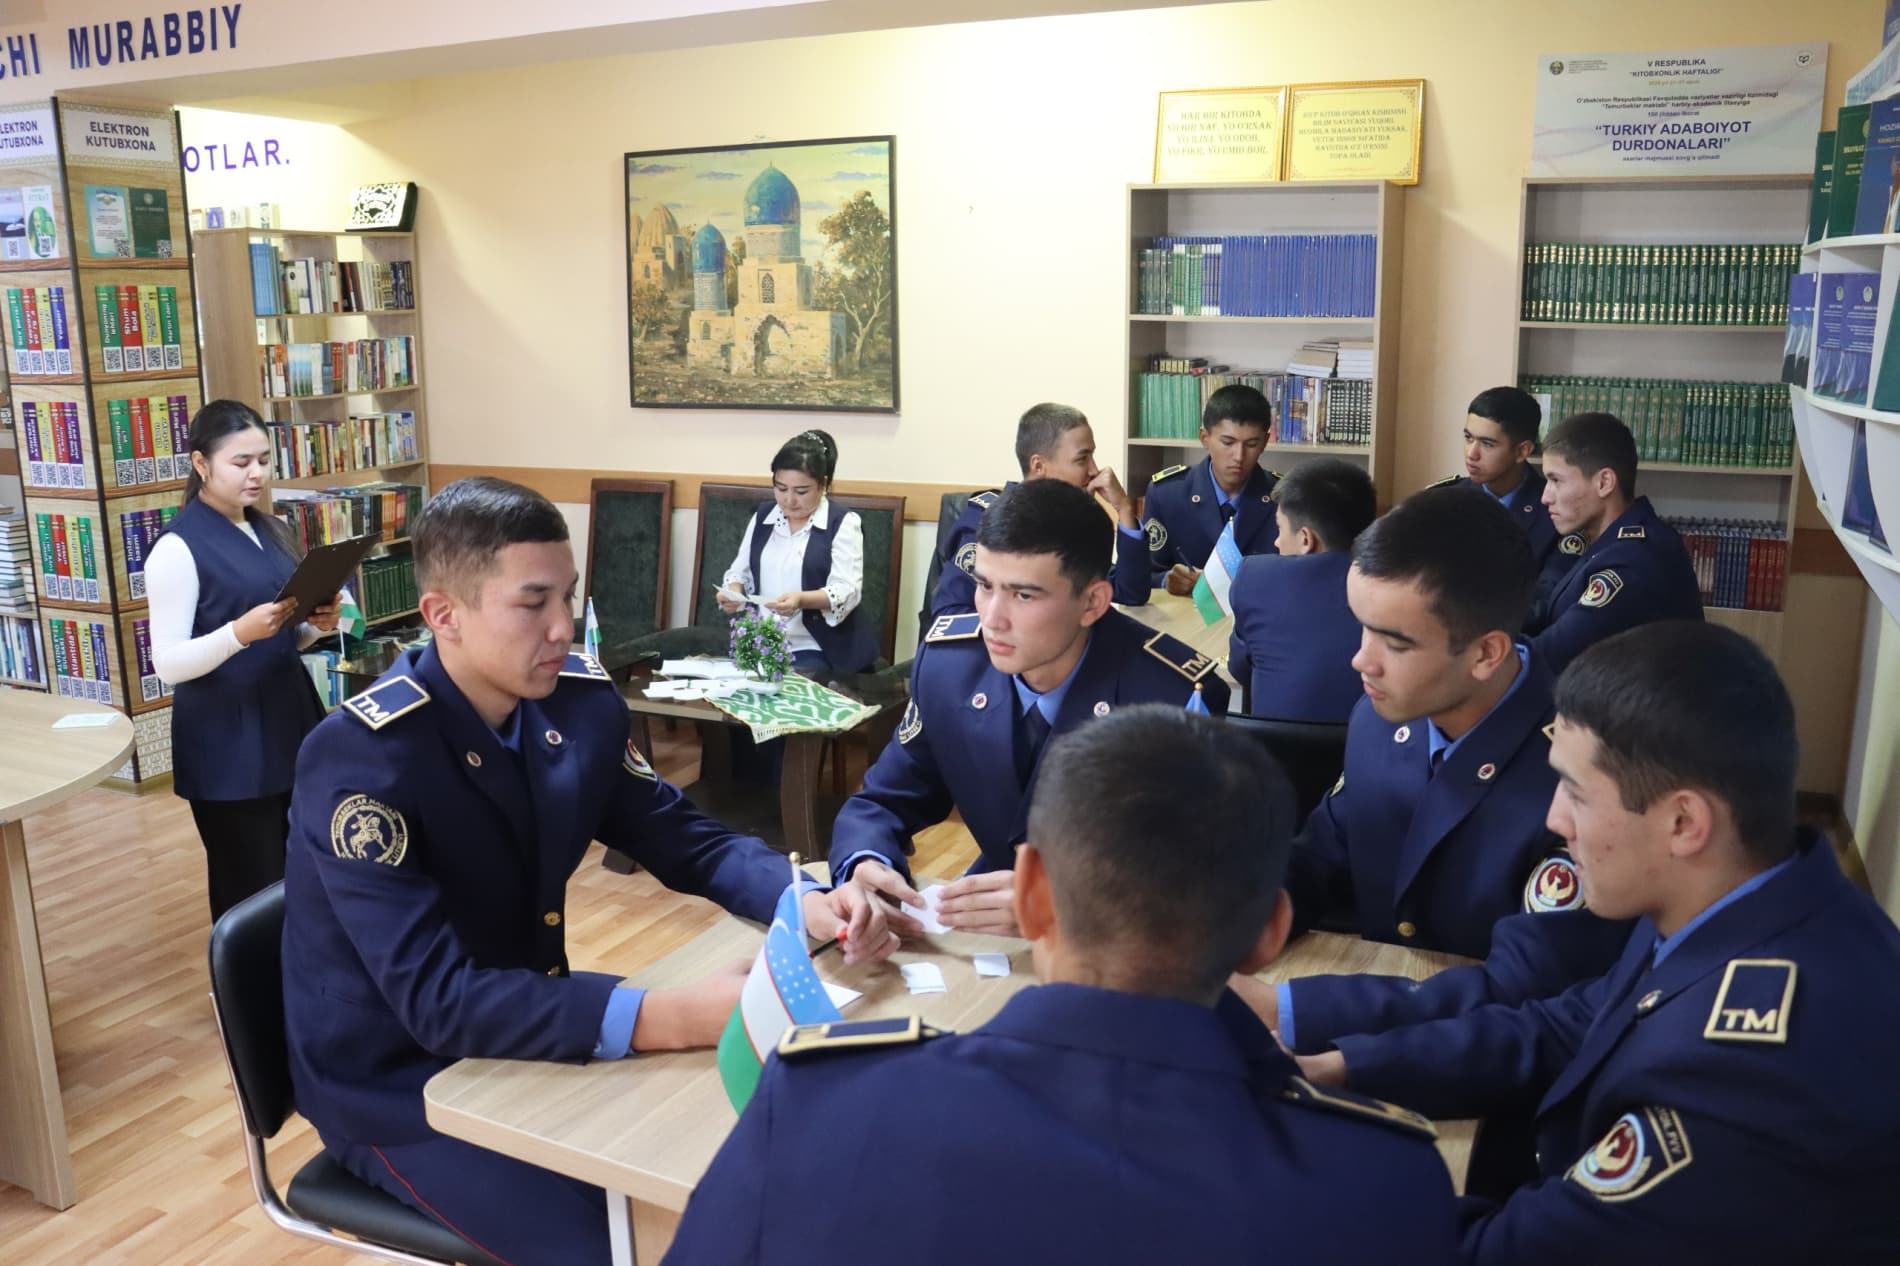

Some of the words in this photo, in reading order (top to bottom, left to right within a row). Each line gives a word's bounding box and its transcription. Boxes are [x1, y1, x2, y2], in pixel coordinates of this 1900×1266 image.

[68, 3, 242, 70] MURABBIY
[1654, 58, 1706, 67] RESPUBLIKA
[90, 121, 150, 137] ELEKTRON
[1659, 120, 1752, 135] ADABOIYOT
[86, 135, 156, 151] KUTUBXONA
[122, 307, 131, 336] Shum
[68, 635, 79, 676] Atlantida
[1181, 653, 1210, 673] TM
[357, 695, 390, 722] TM
[1721, 1008, 1778, 1032] TM
